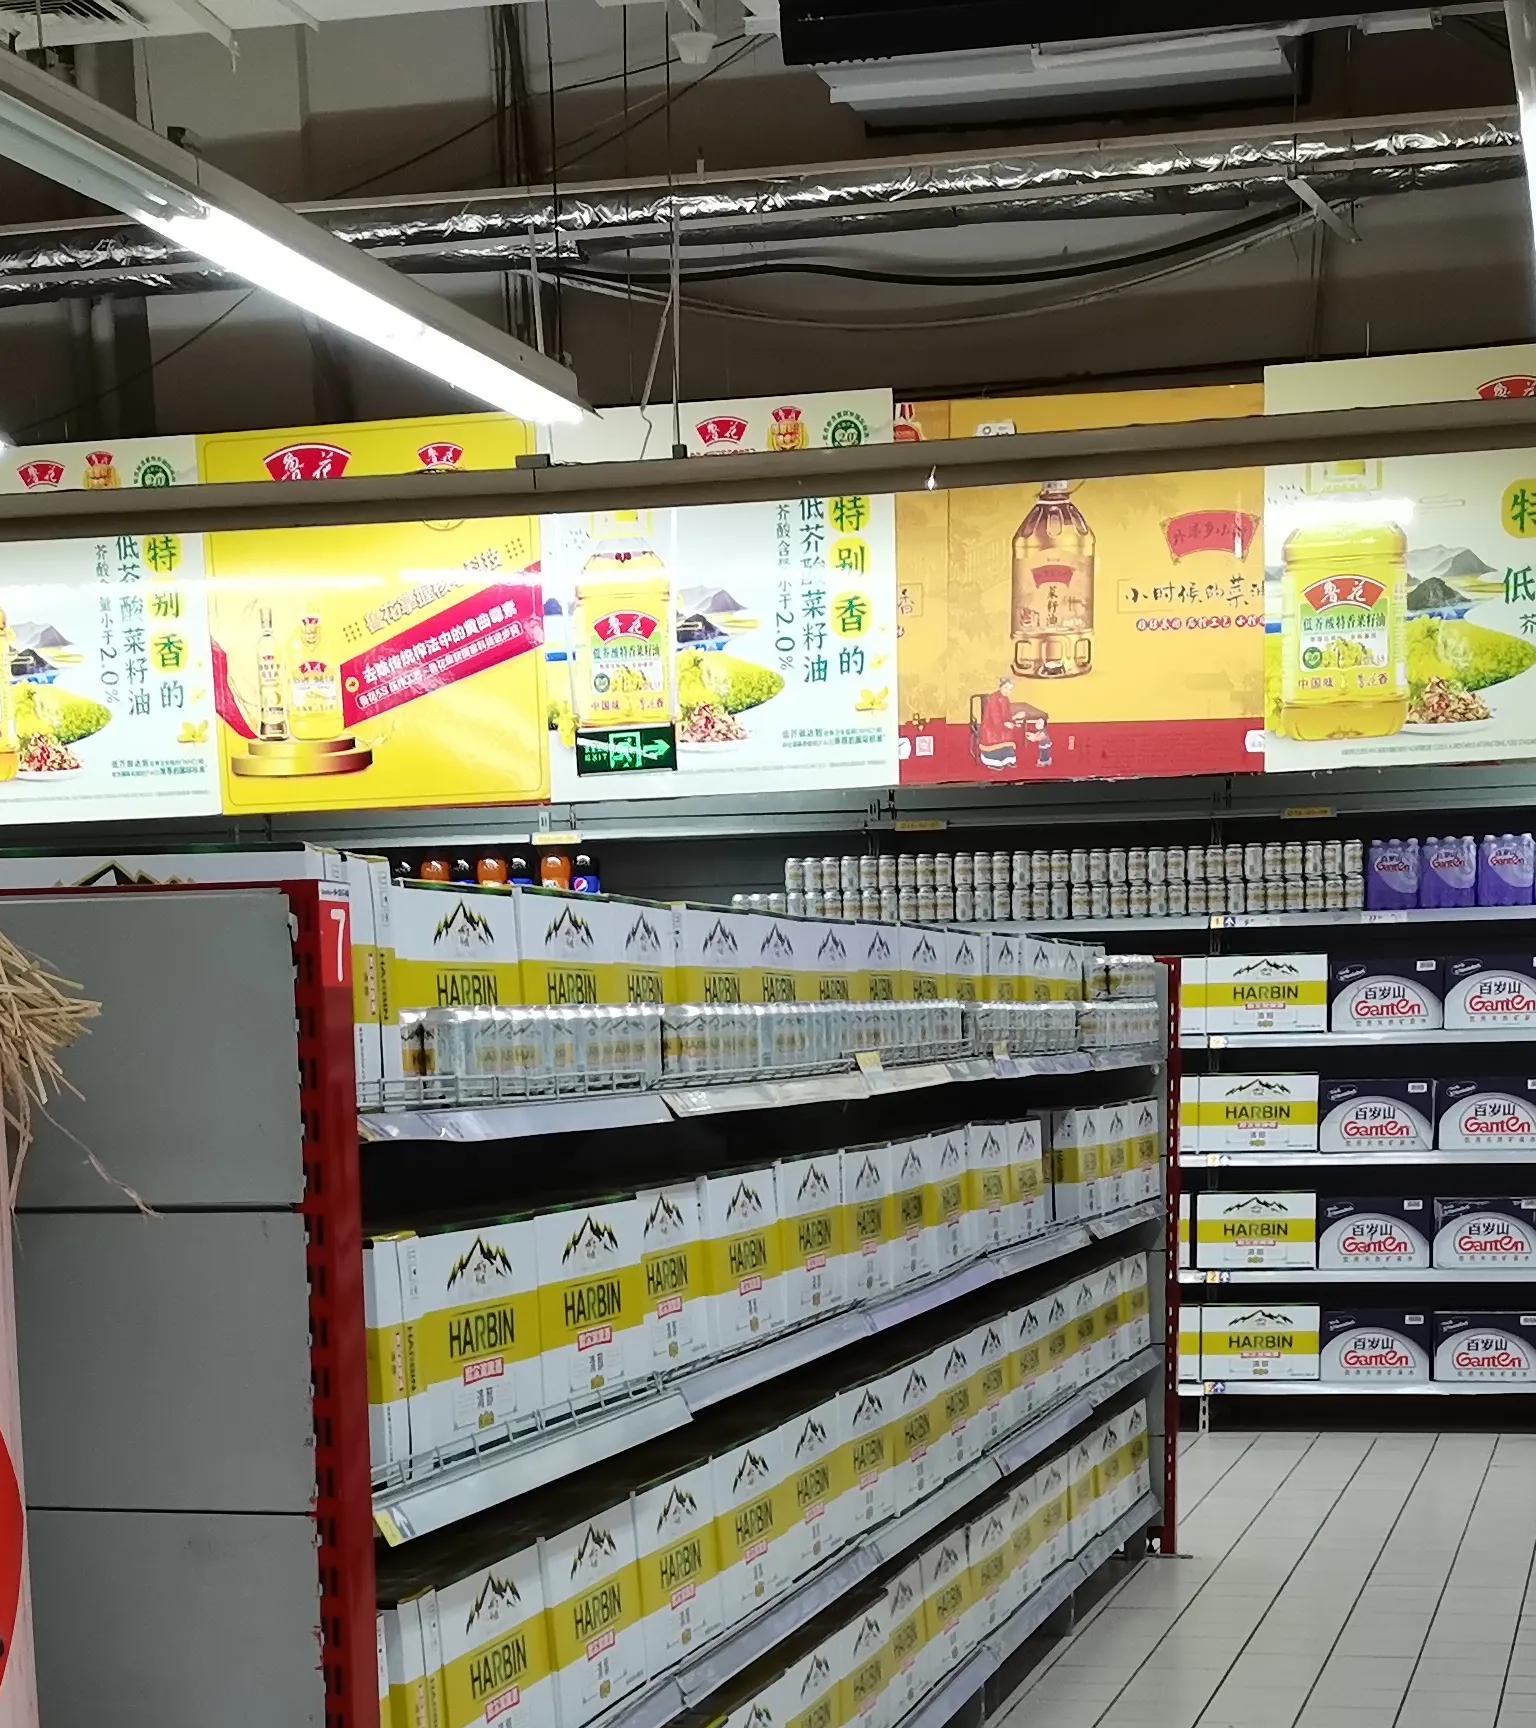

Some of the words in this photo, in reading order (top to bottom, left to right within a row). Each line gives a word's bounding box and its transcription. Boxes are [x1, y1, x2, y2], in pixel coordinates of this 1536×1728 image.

[705, 421, 739, 441] 鲁花
[833, 496, 865, 675] 特别香的
[1320, 580, 1368, 604] 鲁花
[148, 536, 184, 708] 特别香的
[606, 615, 645, 636] 鲁花
[436, 974, 499, 1006] HARBIN
[547, 972, 597, 1005] HARBIN
[627, 973, 663, 1004] HARBIN
[703, 975, 741, 1004] HARBIN
[1233, 985, 1298, 999] HARBIN
[1364, 986, 1406, 999] 百岁山
[1479, 981, 1521, 995] 百岁山
[1355, 999, 1421, 1017] Ganten
[1469, 995, 1536, 1013] Ganten
[1225, 1105, 1290, 1119] HARBIN
[1224, 1222, 1288, 1237] HARBIN
[1352, 1222, 1393, 1237] 百岁山
[1468, 1222, 1509, 1237] 百岁山
[729, 1238, 766, 1274] HARBIN
[1342, 1236, 1408, 1252] Ganten
[1458, 1236, 1525, 1252] Ganten
[646, 1254, 688, 1295] HARBIN
[564, 1280, 622, 1327] HARBIN
[449, 1307, 516, 1359] HARBIN
[1229, 1335, 1293, 1349] HARBIN
[735, 1499, 774, 1546] HARBIN
[660, 1539, 702, 1589] HARBIN
[574, 1583, 622, 1640] HARBIN
[469, 1635, 527, 1700] HARBIN
